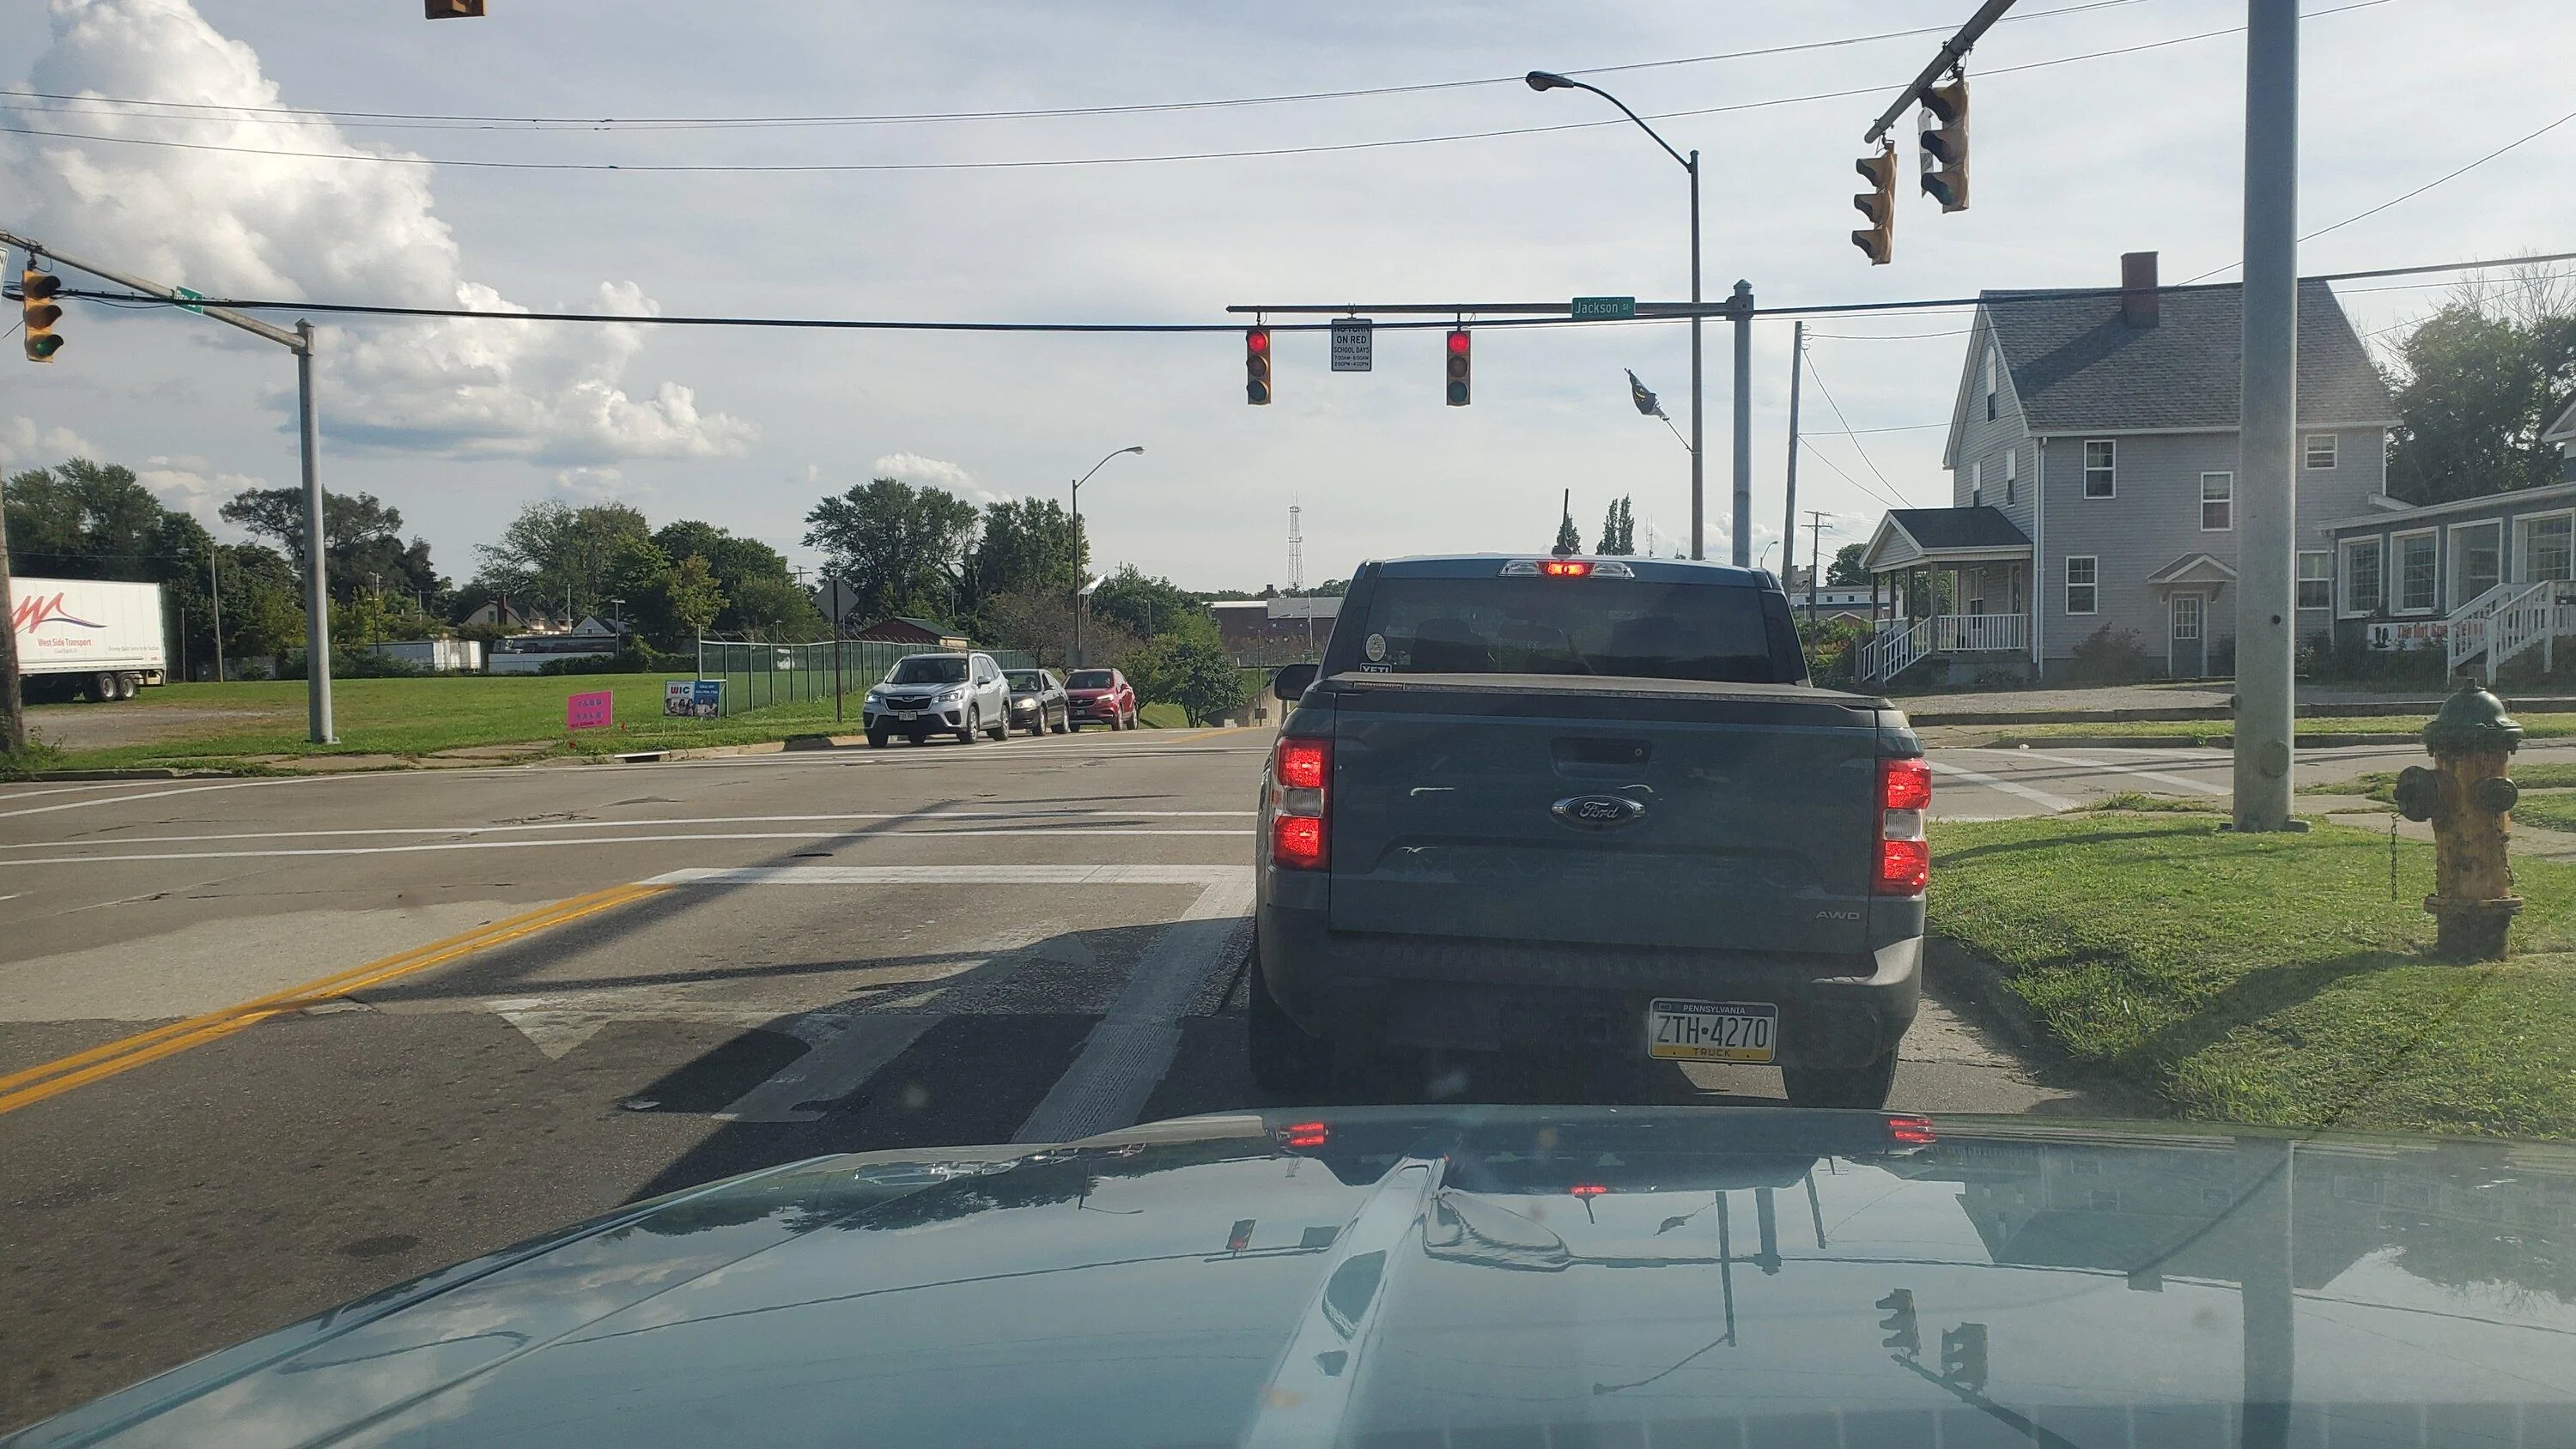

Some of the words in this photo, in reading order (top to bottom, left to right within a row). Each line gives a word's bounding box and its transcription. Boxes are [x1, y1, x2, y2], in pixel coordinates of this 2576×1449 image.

[1575, 301, 1619, 313] Jackson
[1336, 336, 1348, 344] ON
[1351, 336, 1367, 344] RED
[52, 638, 64, 646] Side
[65, 638, 92, 648] Transport
[1579, 801, 1619, 819] Ford
[1814, 911, 1860, 919] AWD
[1683, 1004, 1746, 1015] PENNSYLVANIA
[1693, 1048, 1732, 1058] TRUCK
